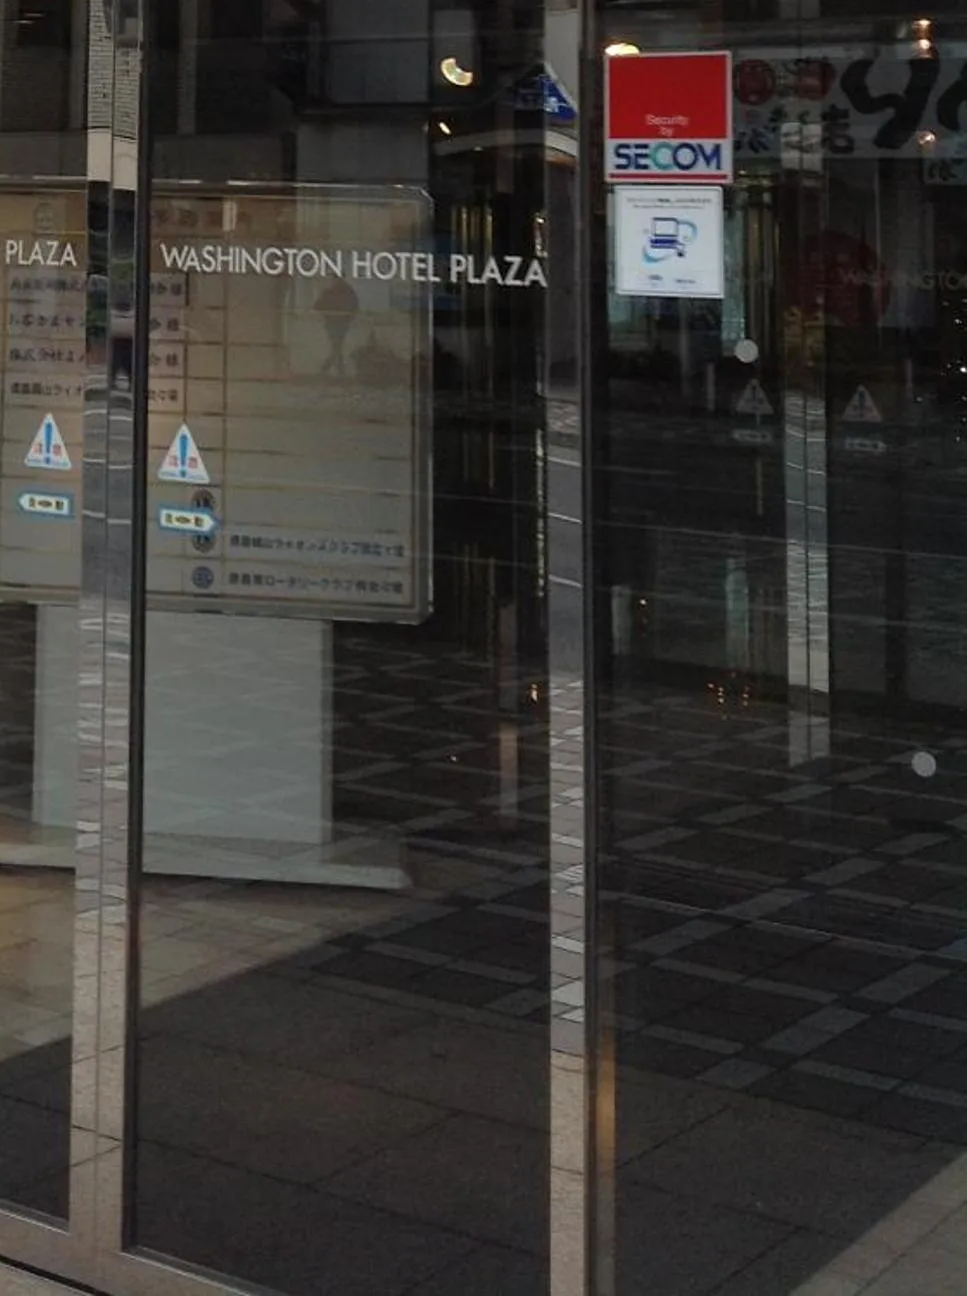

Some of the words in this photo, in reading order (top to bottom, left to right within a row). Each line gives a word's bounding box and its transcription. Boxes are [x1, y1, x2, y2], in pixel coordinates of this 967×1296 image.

[614, 141, 723, 172] SECOM
[5, 239, 78, 267] PLAZA
[159, 243, 343, 278] WASHINGTON
[352, 251, 441, 283] HOTEL
[450, 255, 548, 288] PLAZA
